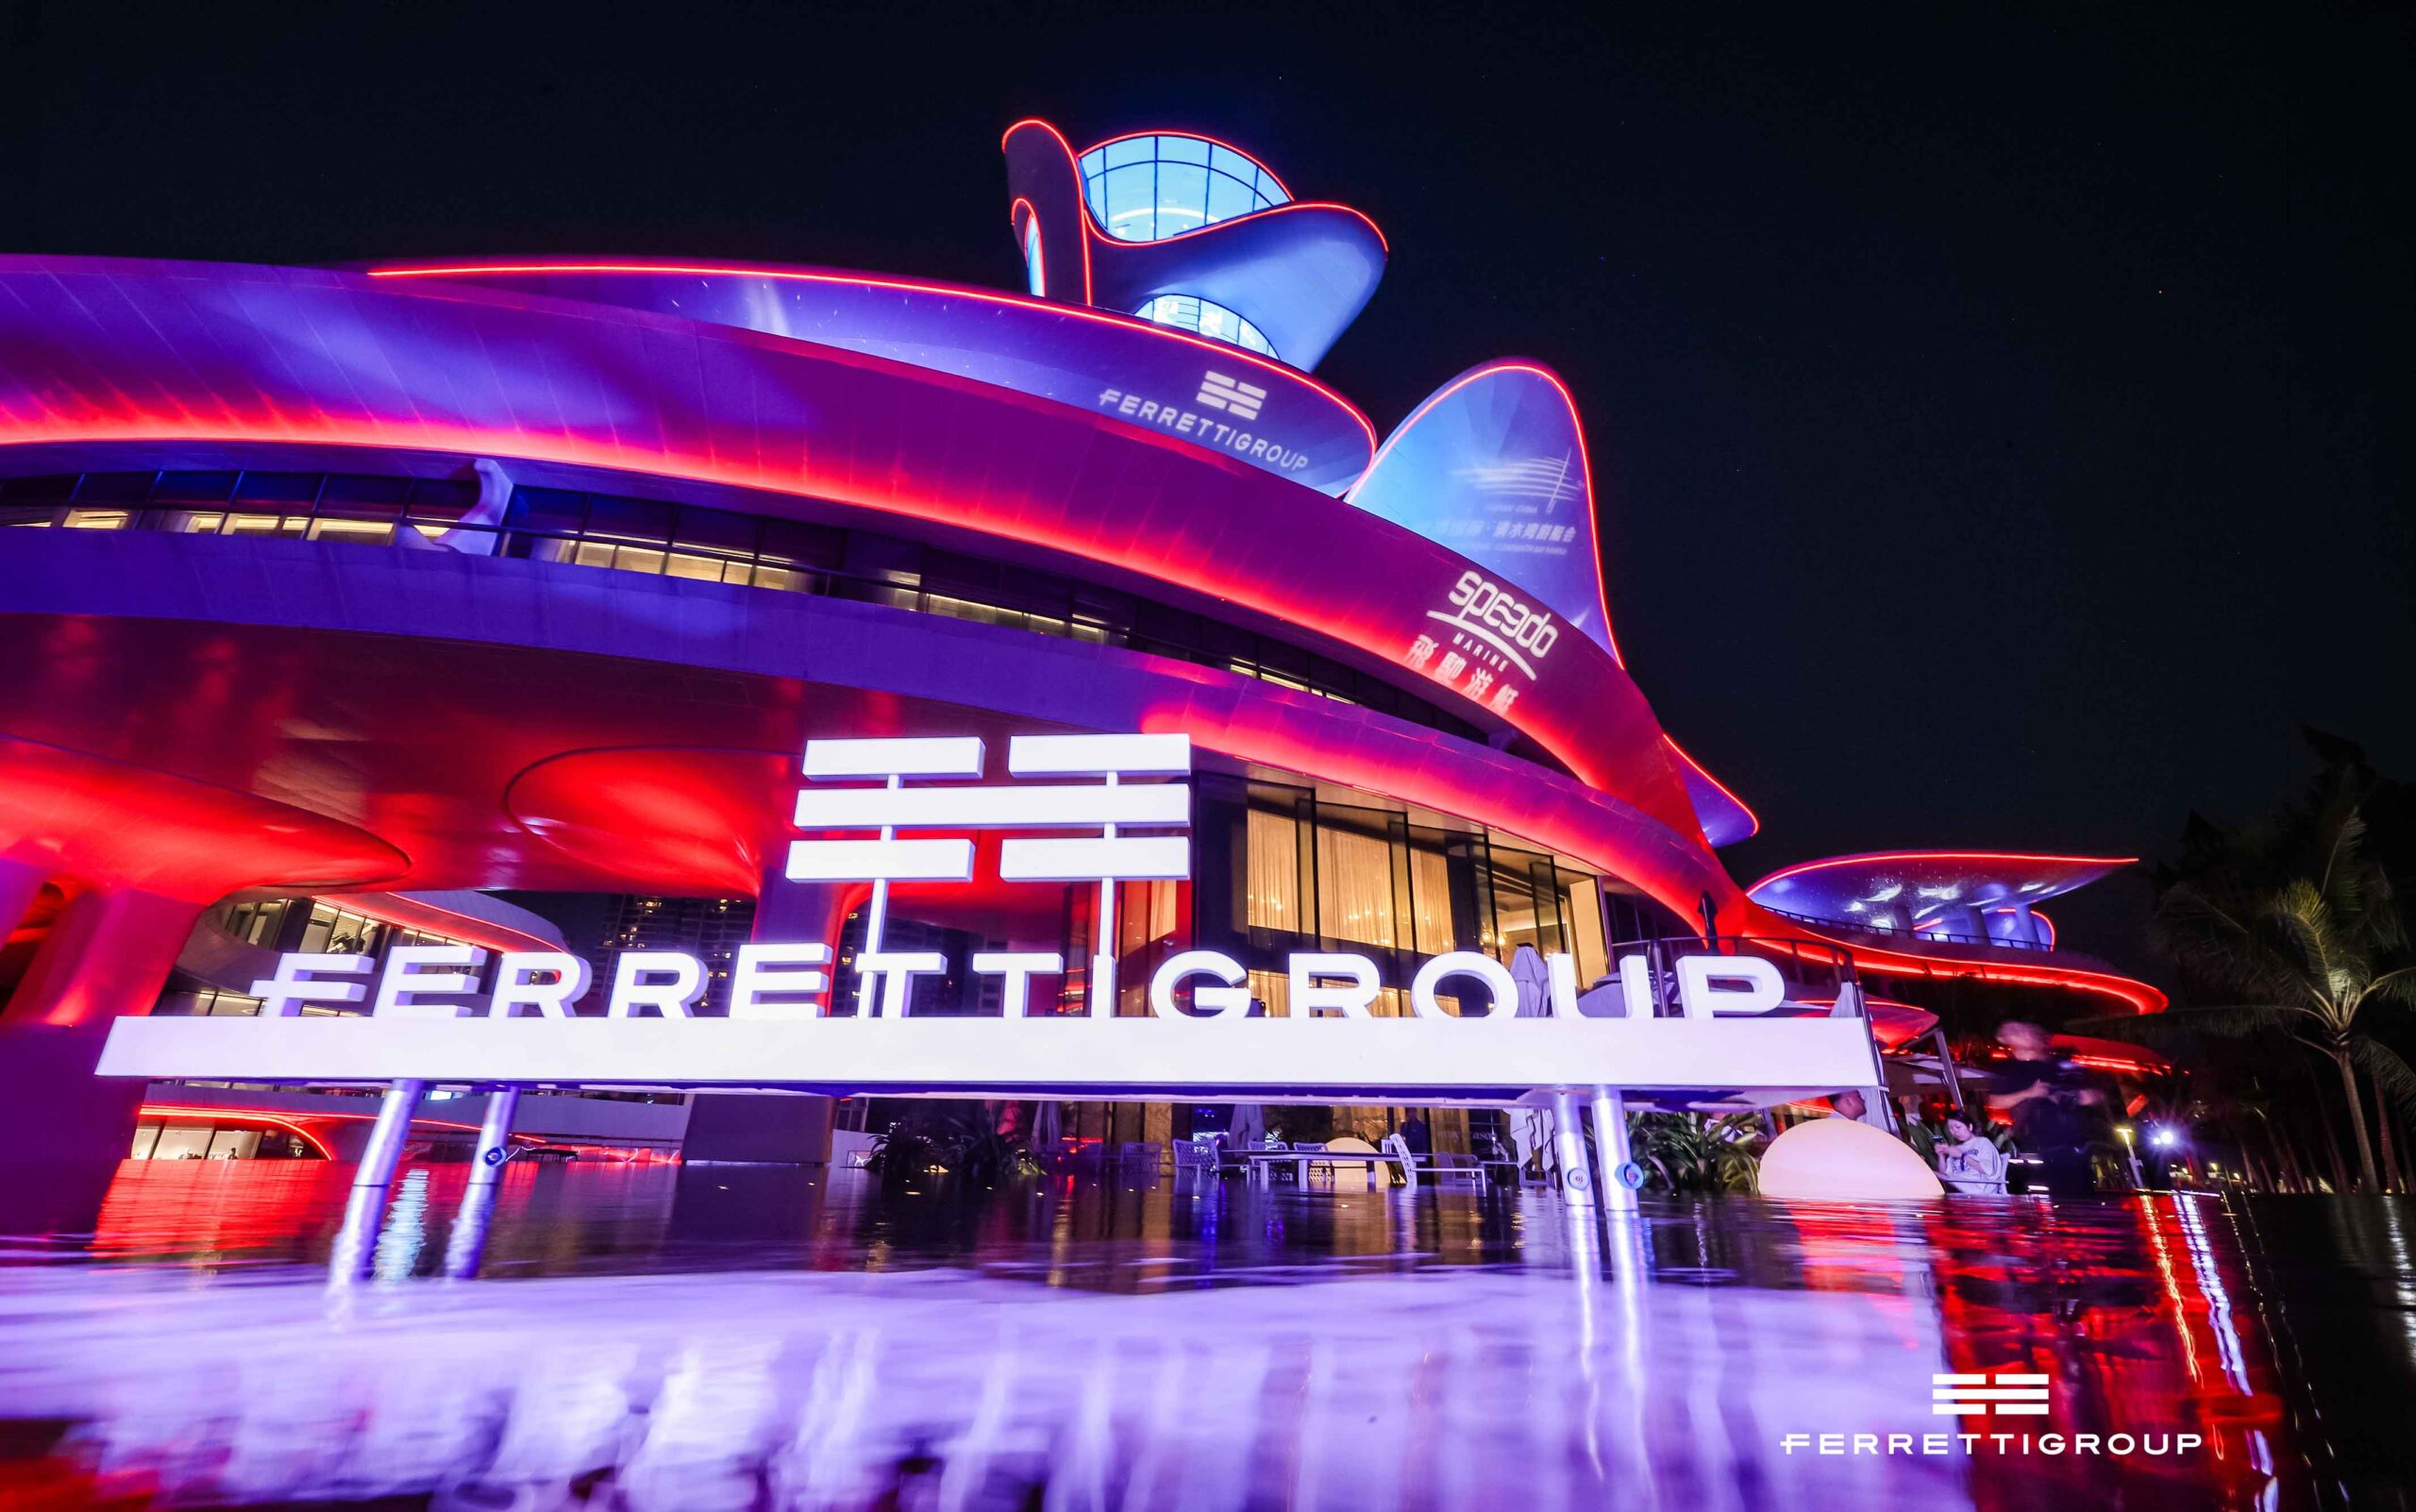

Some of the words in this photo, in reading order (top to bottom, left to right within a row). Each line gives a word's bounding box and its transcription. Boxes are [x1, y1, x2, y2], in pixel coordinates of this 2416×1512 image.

[1099, 388, 1309, 471] FERRETTIGROUP
[1452, 631, 1509, 673] MARINE
[249, 942, 1786, 1019] FERRETTIGROUP
